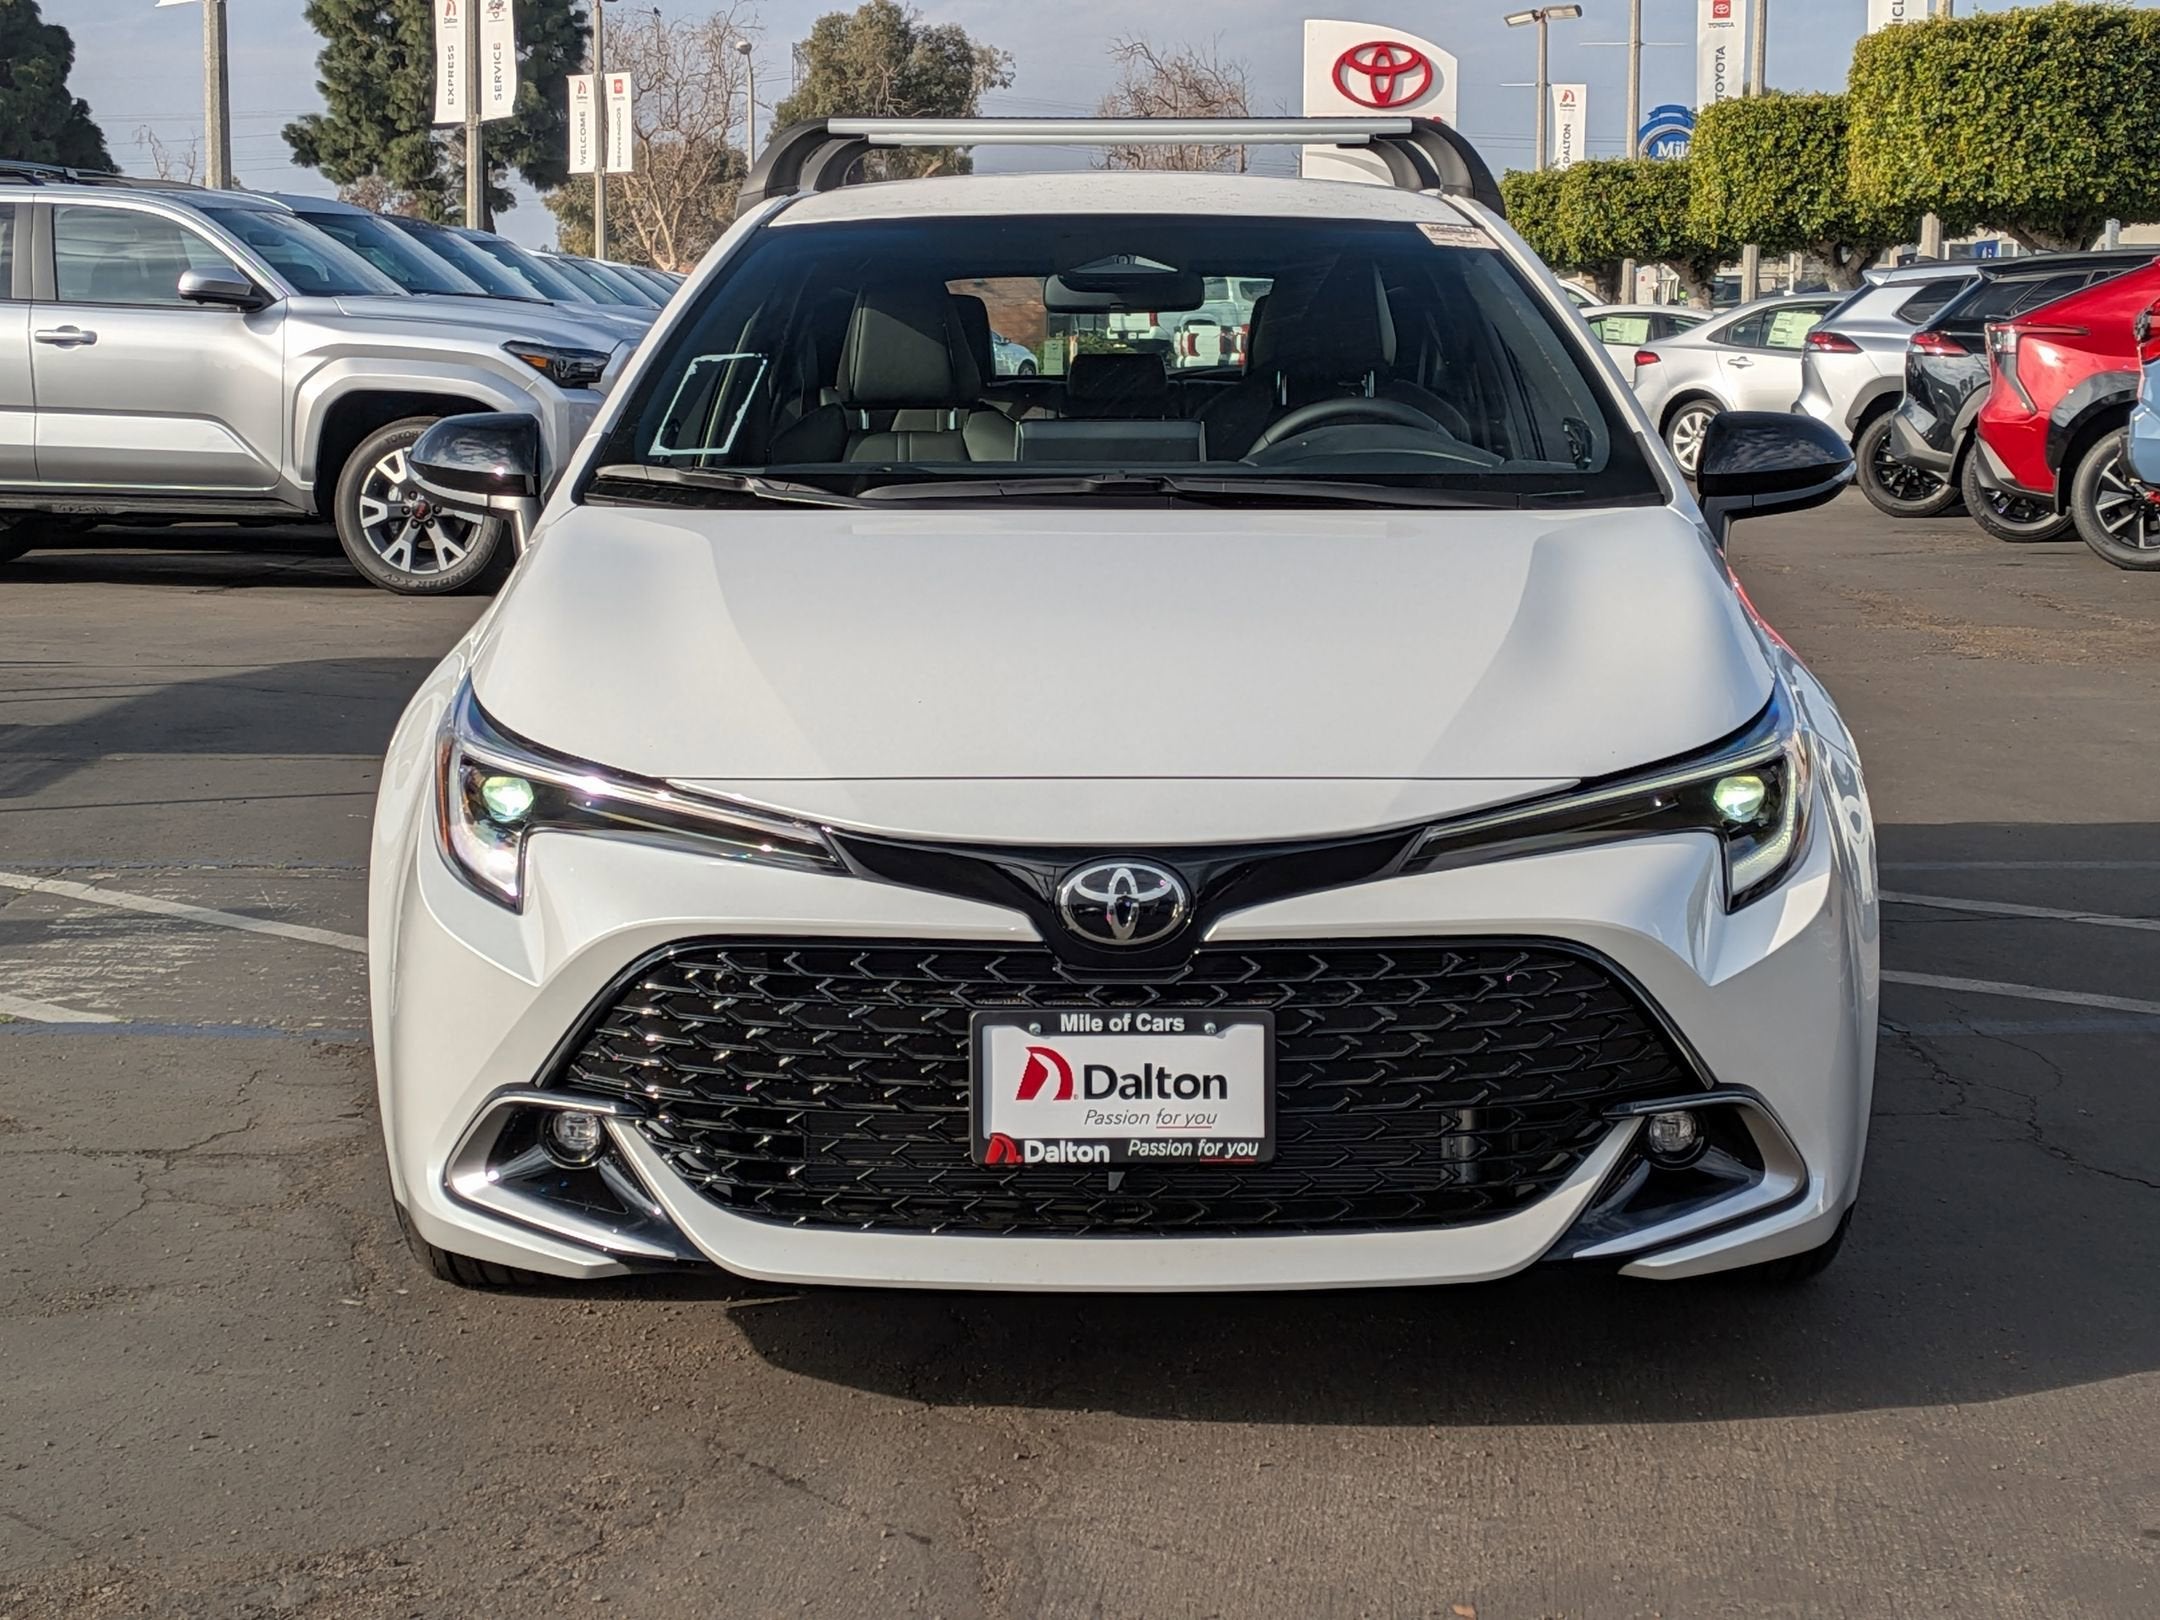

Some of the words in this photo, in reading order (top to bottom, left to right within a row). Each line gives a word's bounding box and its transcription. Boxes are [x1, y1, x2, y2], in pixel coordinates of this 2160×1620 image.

[447, 44, 455, 106] EXPRESS
[493, 42, 503, 102] SERVICE
[1714, 45, 1726, 100] TOYOTA
[579, 111, 587, 166] WELCOME
[1562, 123, 1572, 164] DALTON
[1060, 1013, 1103, 1032] Mile
[1109, 1013, 1132, 1032] of
[1135, 1013, 1185, 1032] Cars
[1083, 1063, 1228, 1101] Dalton
[1084, 1109, 1151, 1126] Passion
[1154, 1108, 1181, 1126] for
[1184, 1112, 1218, 1126] you
[1024, 1140, 1110, 1163] Dalton
[1127, 1139, 1193, 1157] Passion
[1198, 1139, 1224, 1156] for
[1227, 1141, 1259, 1157] you
